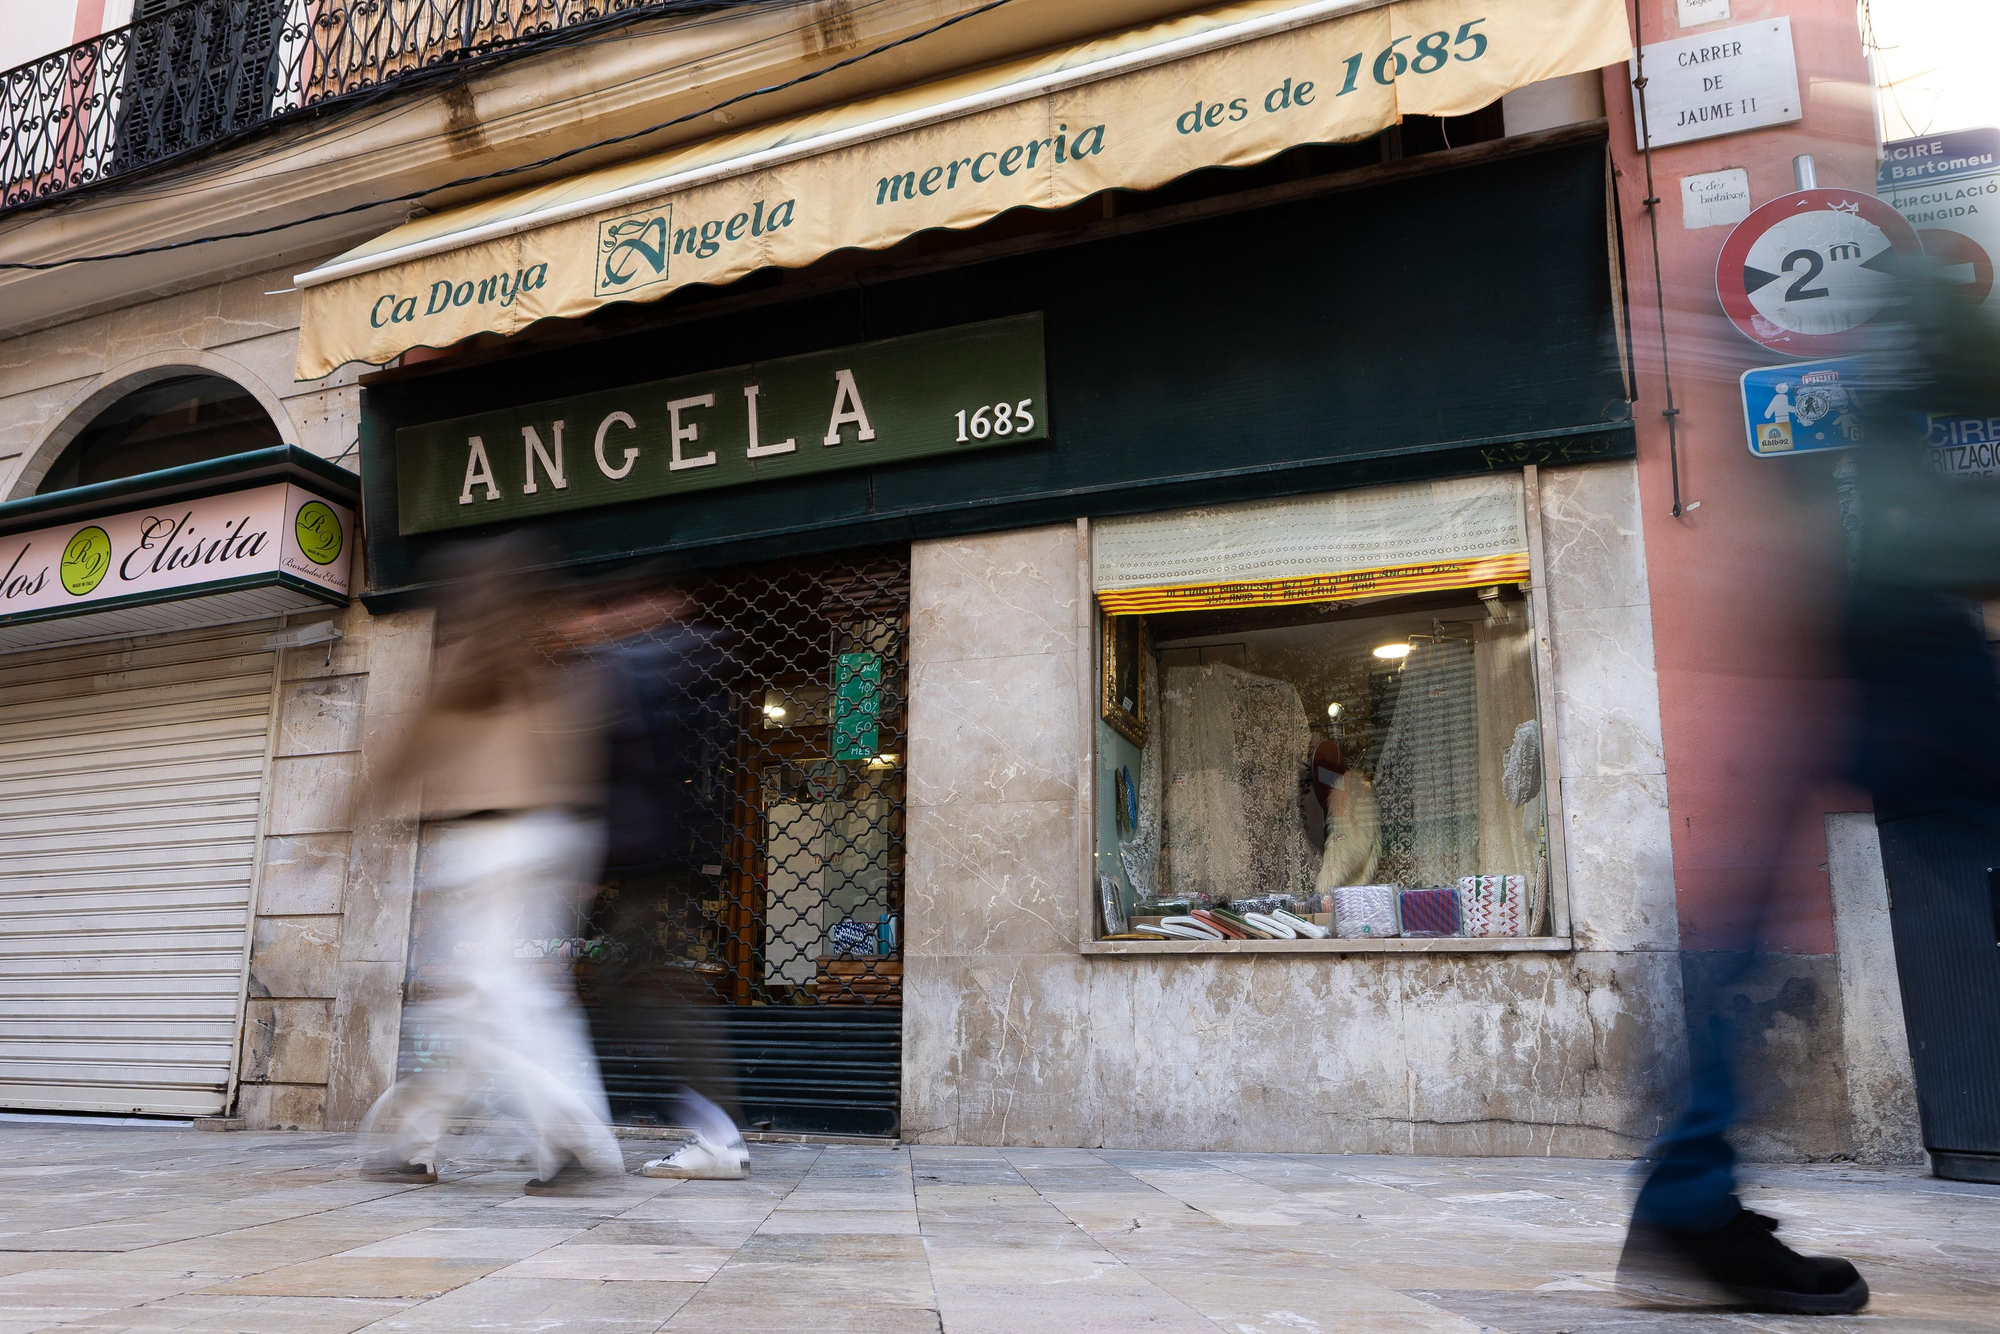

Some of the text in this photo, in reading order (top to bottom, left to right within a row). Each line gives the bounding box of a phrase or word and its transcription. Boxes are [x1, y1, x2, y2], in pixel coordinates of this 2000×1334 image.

[1677, 41, 1743, 68] CARRER
[1702, 75, 1725, 93] DE
[1677, 97, 1757, 127] JAUME II
[369, 17, 1489, 329] Ca Donya Angela merceria des de 1685
[1891, 153, 1993, 180] Bartomeu
[1891, 180, 1998, 210] CIRCULACIÓ
[1906, 204, 1979, 223] RINGIDA
[457, 369, 1035, 505] ANGELA 1685
[119, 511, 270, 582] Elisita
[281, 557, 348, 589] Bordados Elisita
